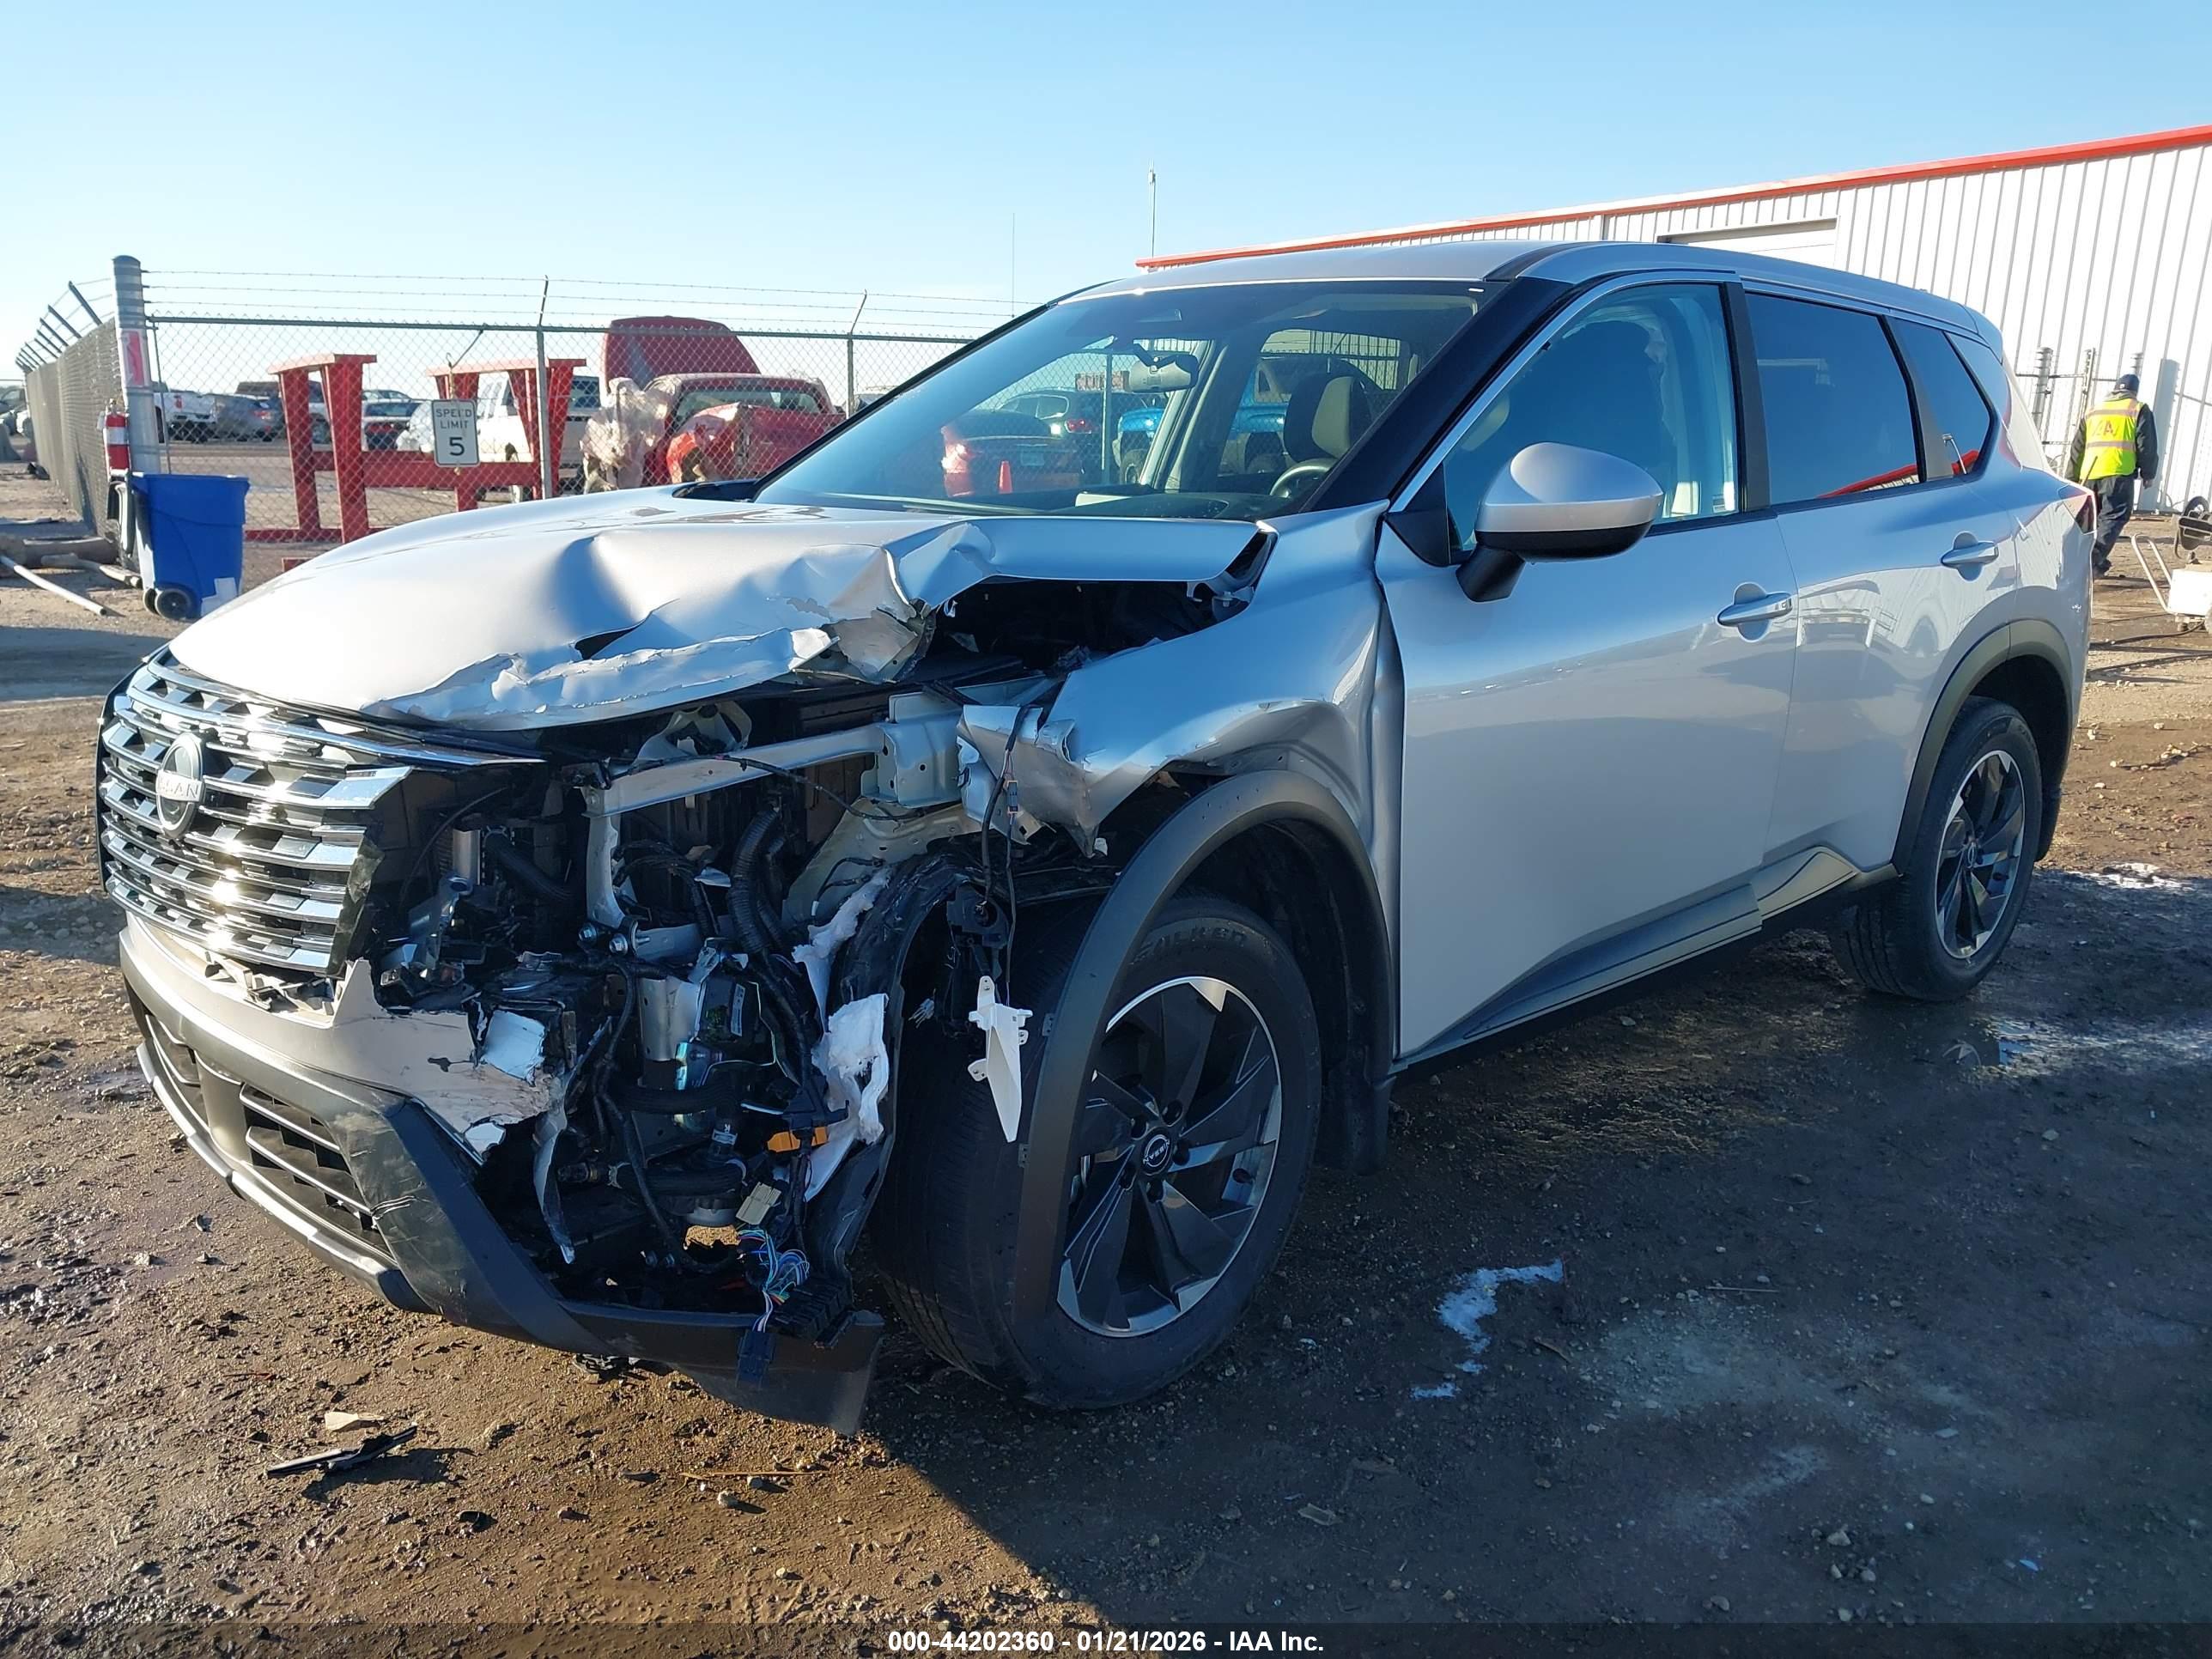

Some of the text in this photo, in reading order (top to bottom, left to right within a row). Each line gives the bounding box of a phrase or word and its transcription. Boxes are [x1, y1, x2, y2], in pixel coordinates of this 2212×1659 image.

[441, 420, 469, 429] LIMIT
[449, 436, 465, 456] 5
[157, 774, 199, 799] SSAN
